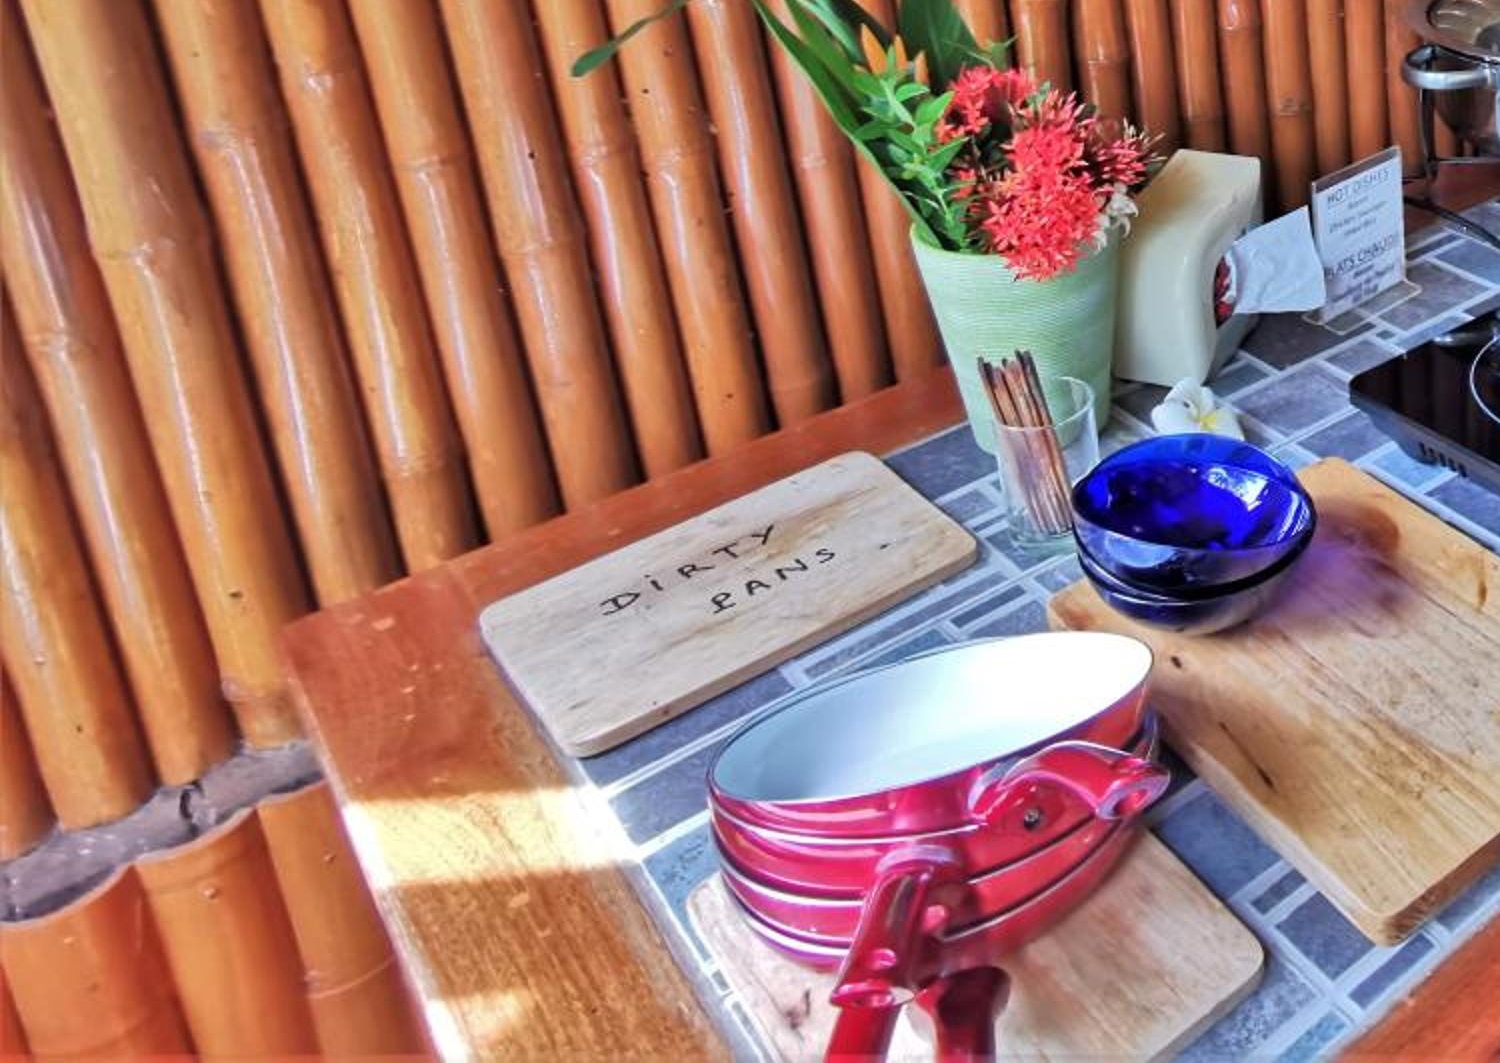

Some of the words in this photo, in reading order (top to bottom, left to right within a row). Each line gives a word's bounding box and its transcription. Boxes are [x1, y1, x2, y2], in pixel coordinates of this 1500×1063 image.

[1327, 184, 1350, 202] HOT
[1352, 168, 1389, 193] DISHES
[711, 547, 836, 614] PANS
